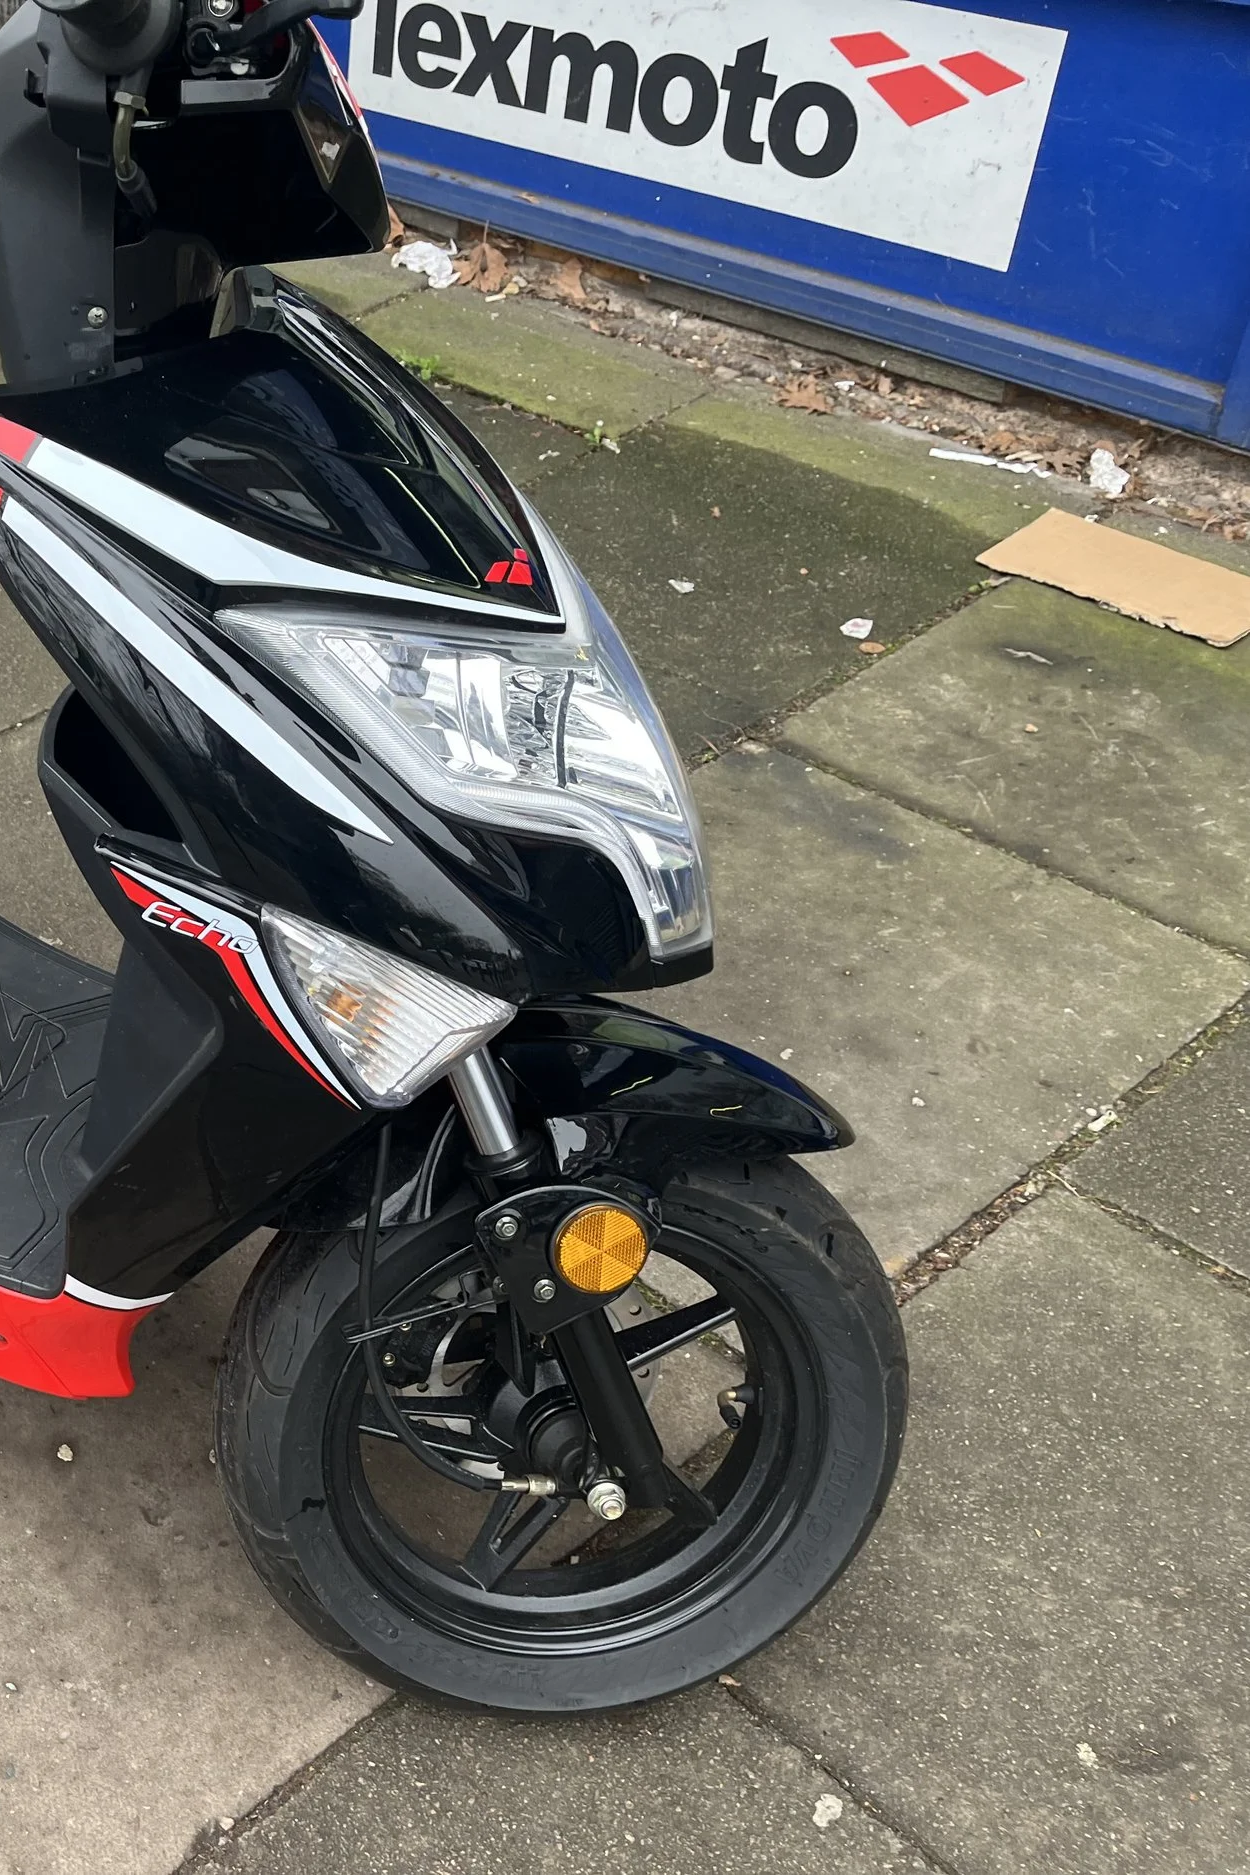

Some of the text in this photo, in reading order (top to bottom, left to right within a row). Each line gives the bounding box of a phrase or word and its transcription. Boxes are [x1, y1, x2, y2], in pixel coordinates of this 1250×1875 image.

[372, 0, 859, 179] lexmoto
[140, 900, 260, 955] Echo
[773, 1447, 860, 1587] INNOVA
